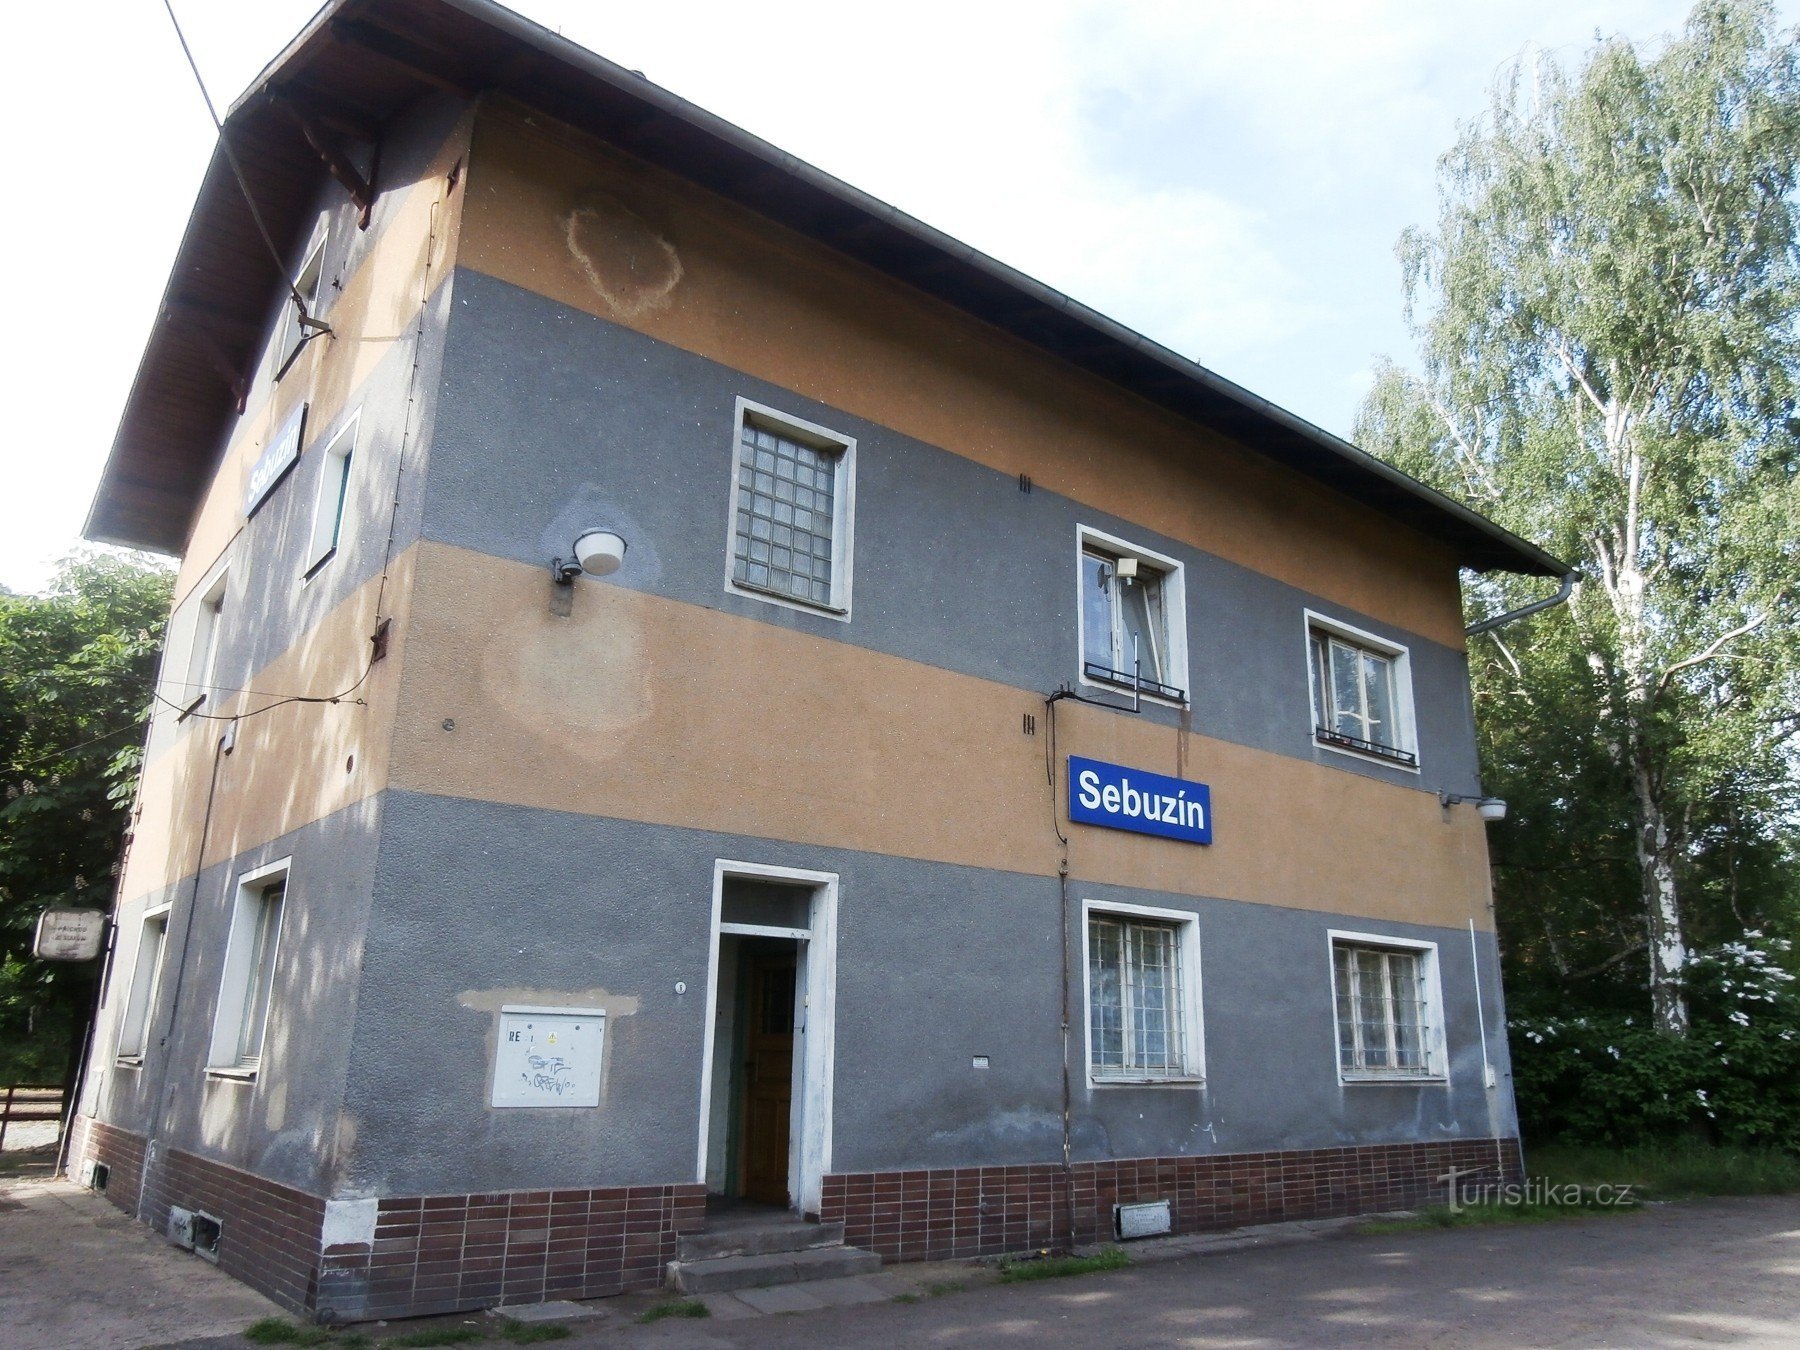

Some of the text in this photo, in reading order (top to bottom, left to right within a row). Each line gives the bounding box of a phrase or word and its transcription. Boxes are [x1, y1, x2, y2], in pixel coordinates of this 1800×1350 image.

[248, 423, 298, 503] Sebuzín
[1079, 770, 1204, 829] Sebuzín
[509, 1031, 521, 1042] RE
